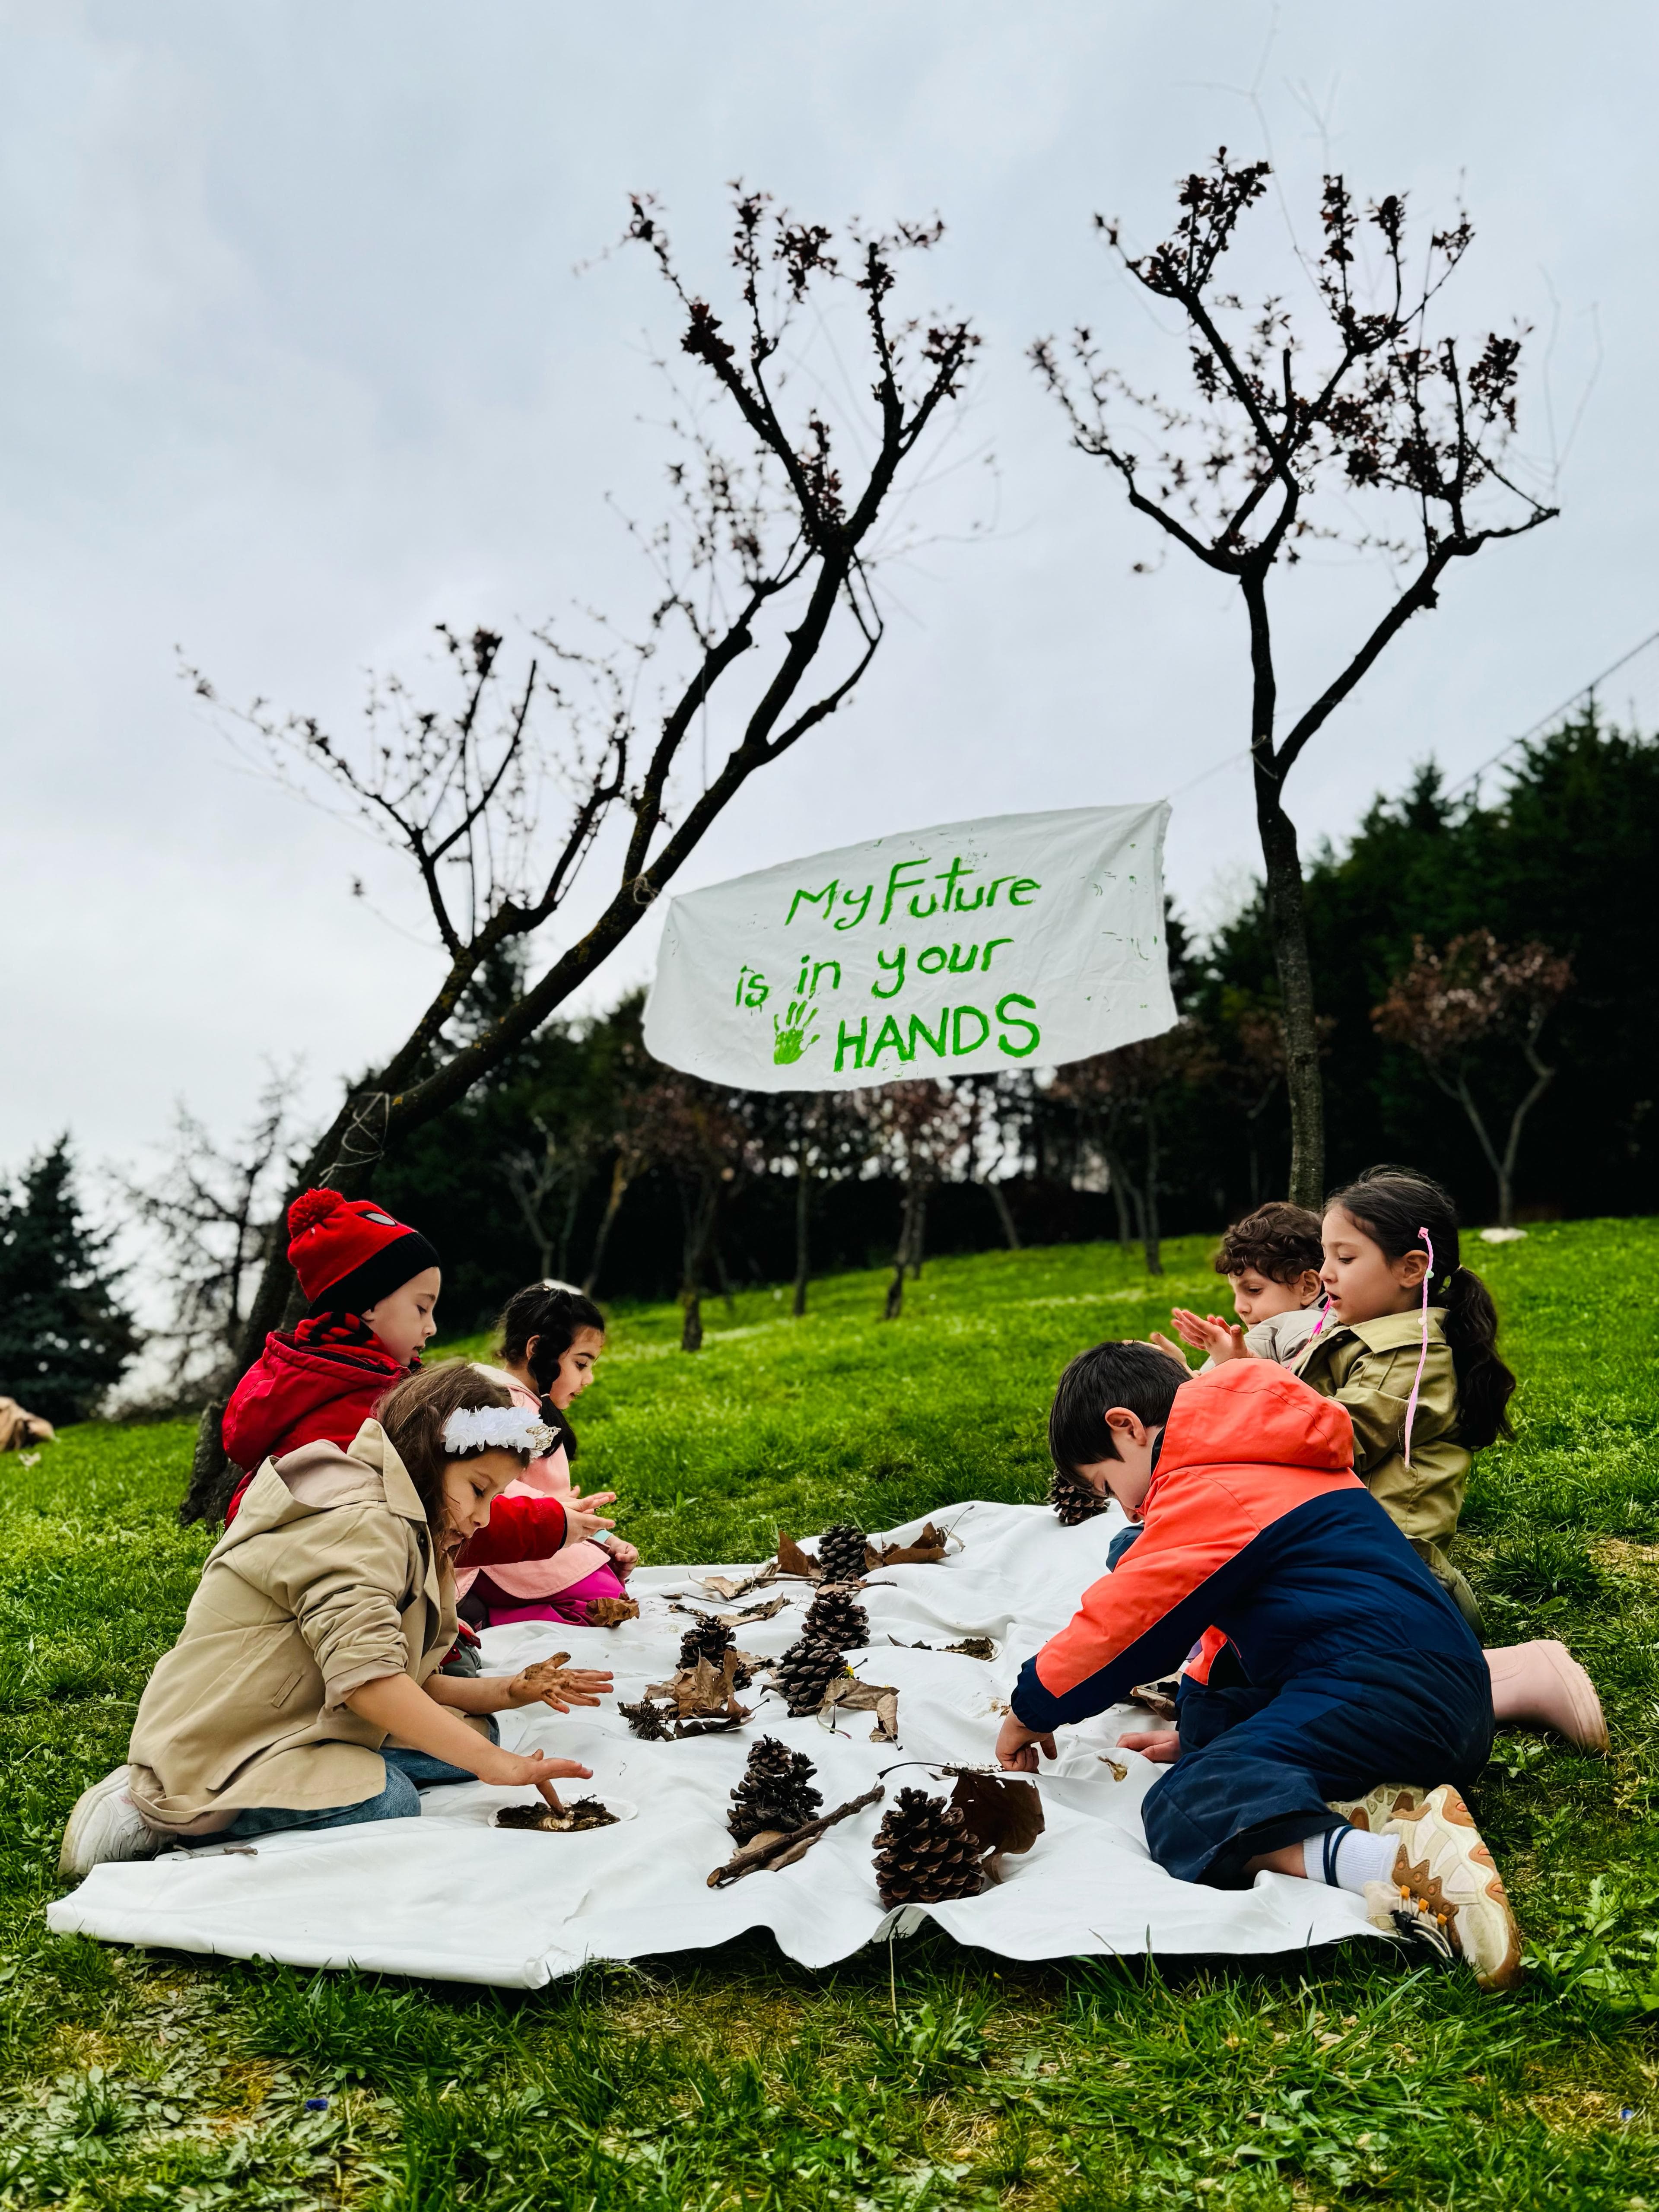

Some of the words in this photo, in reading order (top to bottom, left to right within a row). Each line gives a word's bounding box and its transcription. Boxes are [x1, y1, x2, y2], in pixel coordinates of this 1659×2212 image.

[785, 880, 874, 931] My
[878, 856, 1042, 925] Future
[735, 965, 770, 1009] is
[796, 955, 841, 999] in
[871, 938, 1014, 999] your
[833, 993, 1041, 1072] HANDS
